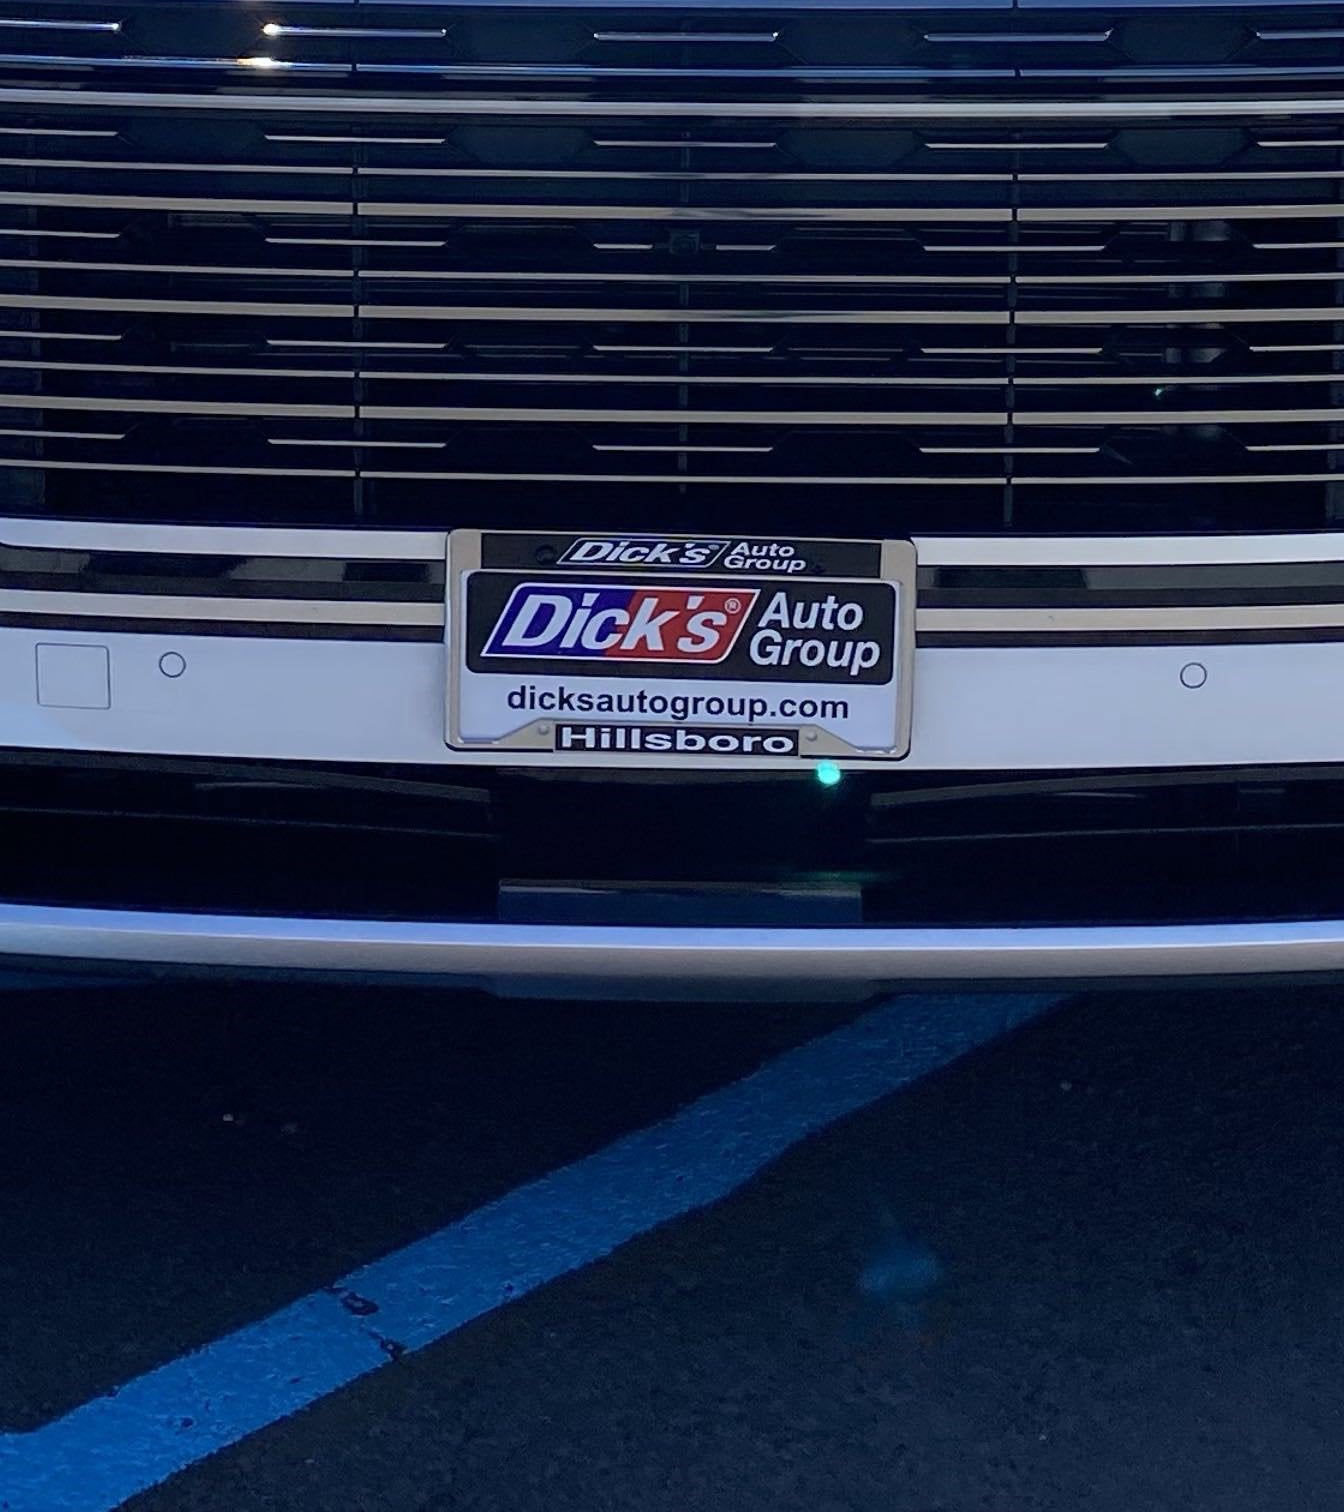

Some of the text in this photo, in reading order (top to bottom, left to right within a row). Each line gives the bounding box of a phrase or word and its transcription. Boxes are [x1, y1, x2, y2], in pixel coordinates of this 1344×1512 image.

[724, 555, 806, 573] Group
[731, 542, 794, 557] Auto
[758, 592, 863, 631] Auto
[749, 628, 881, 675] Group
[507, 685, 849, 722] dicksautogroup.com
[561, 726, 794, 754] Hillsboro
